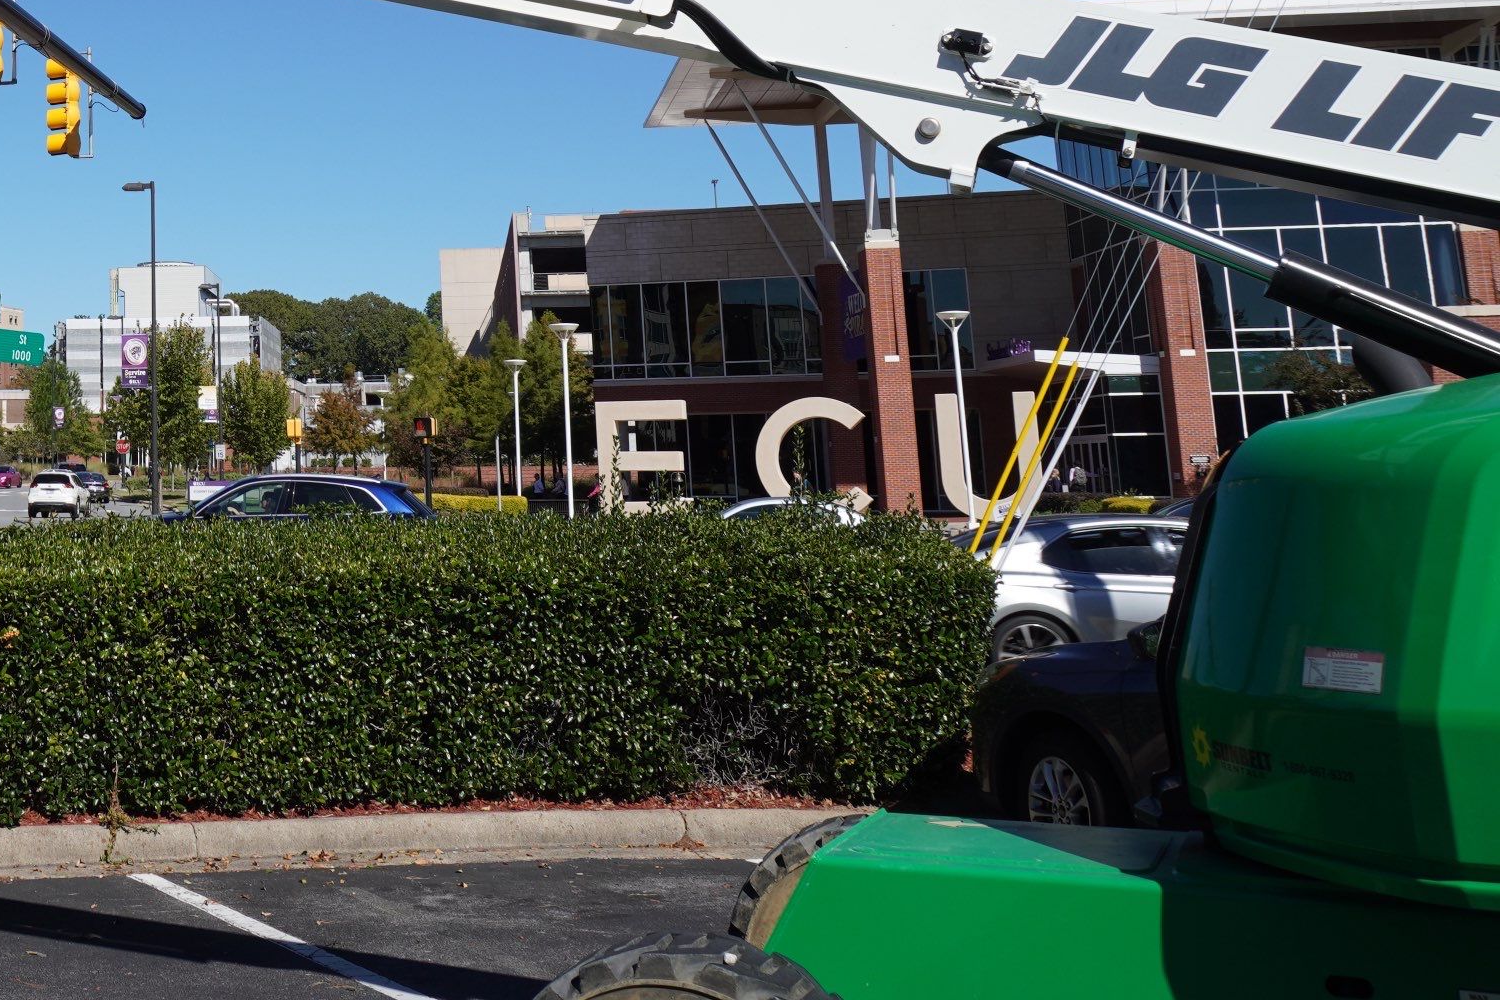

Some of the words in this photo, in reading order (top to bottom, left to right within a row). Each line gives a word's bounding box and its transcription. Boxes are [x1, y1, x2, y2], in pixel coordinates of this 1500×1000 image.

[1001, 15, 1268, 118] JLG
[12, 349, 31, 362] 1000
[18, 334, 28, 346] St
[595, 391, 1042, 521] ECU
[1212, 740, 1272, 771] SUNBELT
